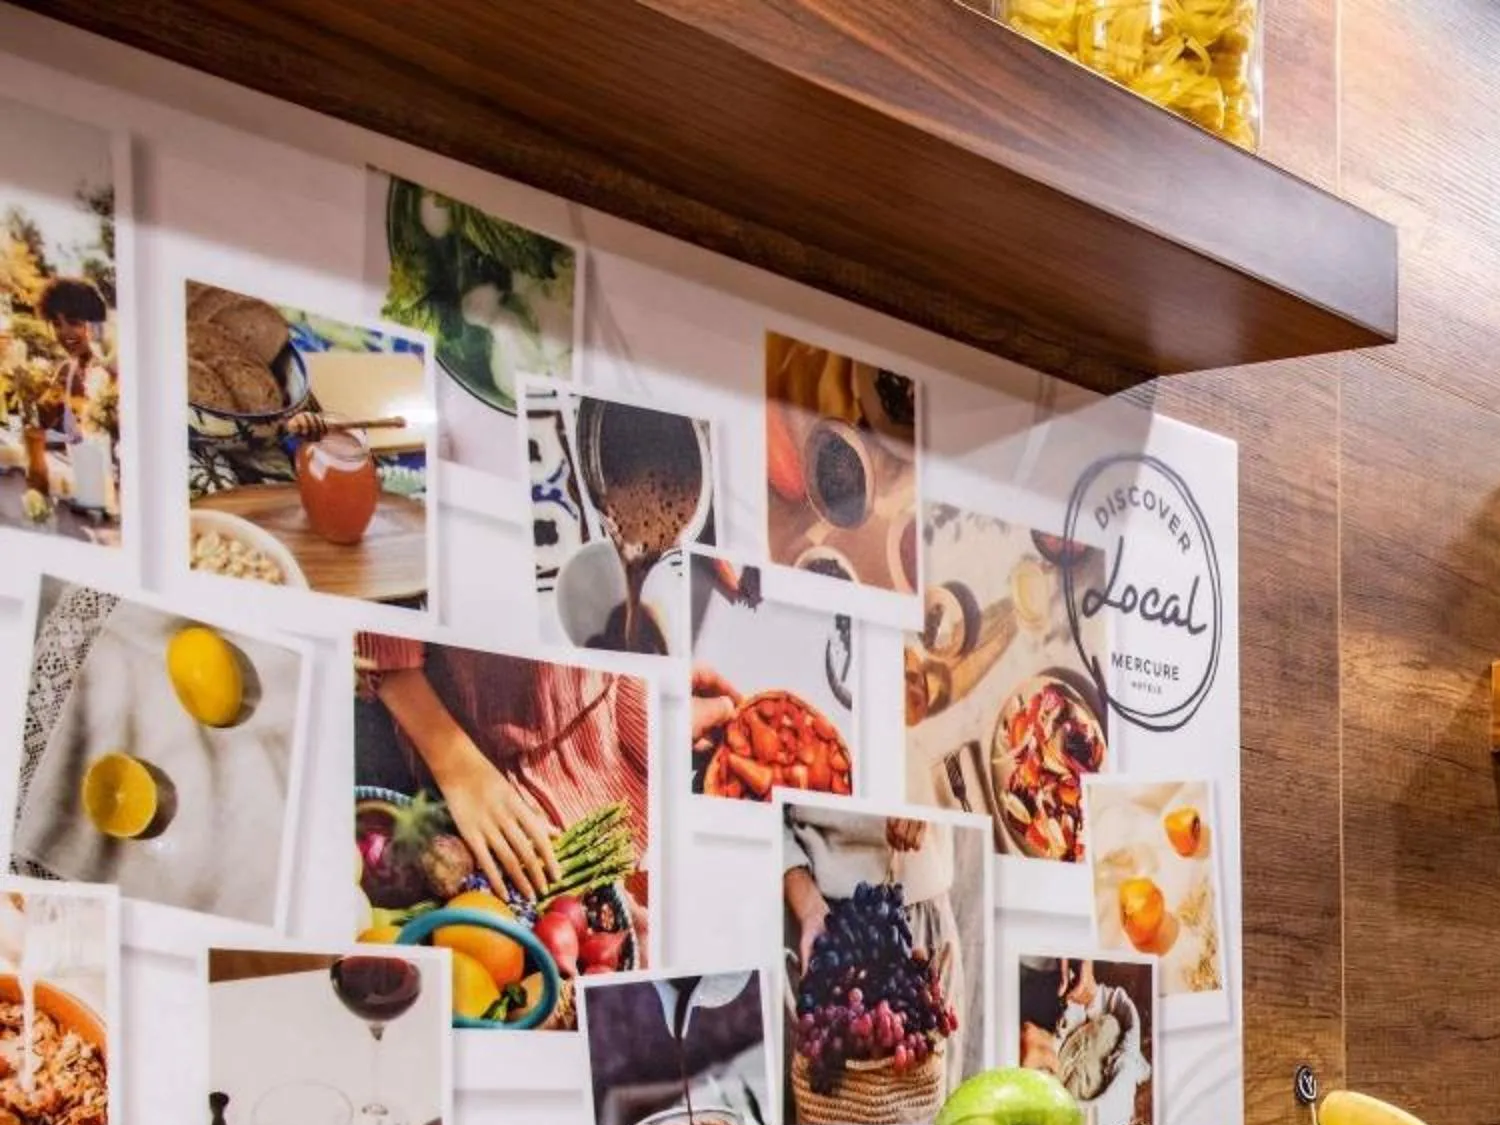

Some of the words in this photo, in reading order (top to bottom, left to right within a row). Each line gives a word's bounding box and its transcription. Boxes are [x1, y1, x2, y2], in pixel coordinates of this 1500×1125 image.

[1094, 486, 1192, 554] DISCOVER
[1082, 535, 1207, 635] Local
[1111, 652, 1180, 681] MERCURE
